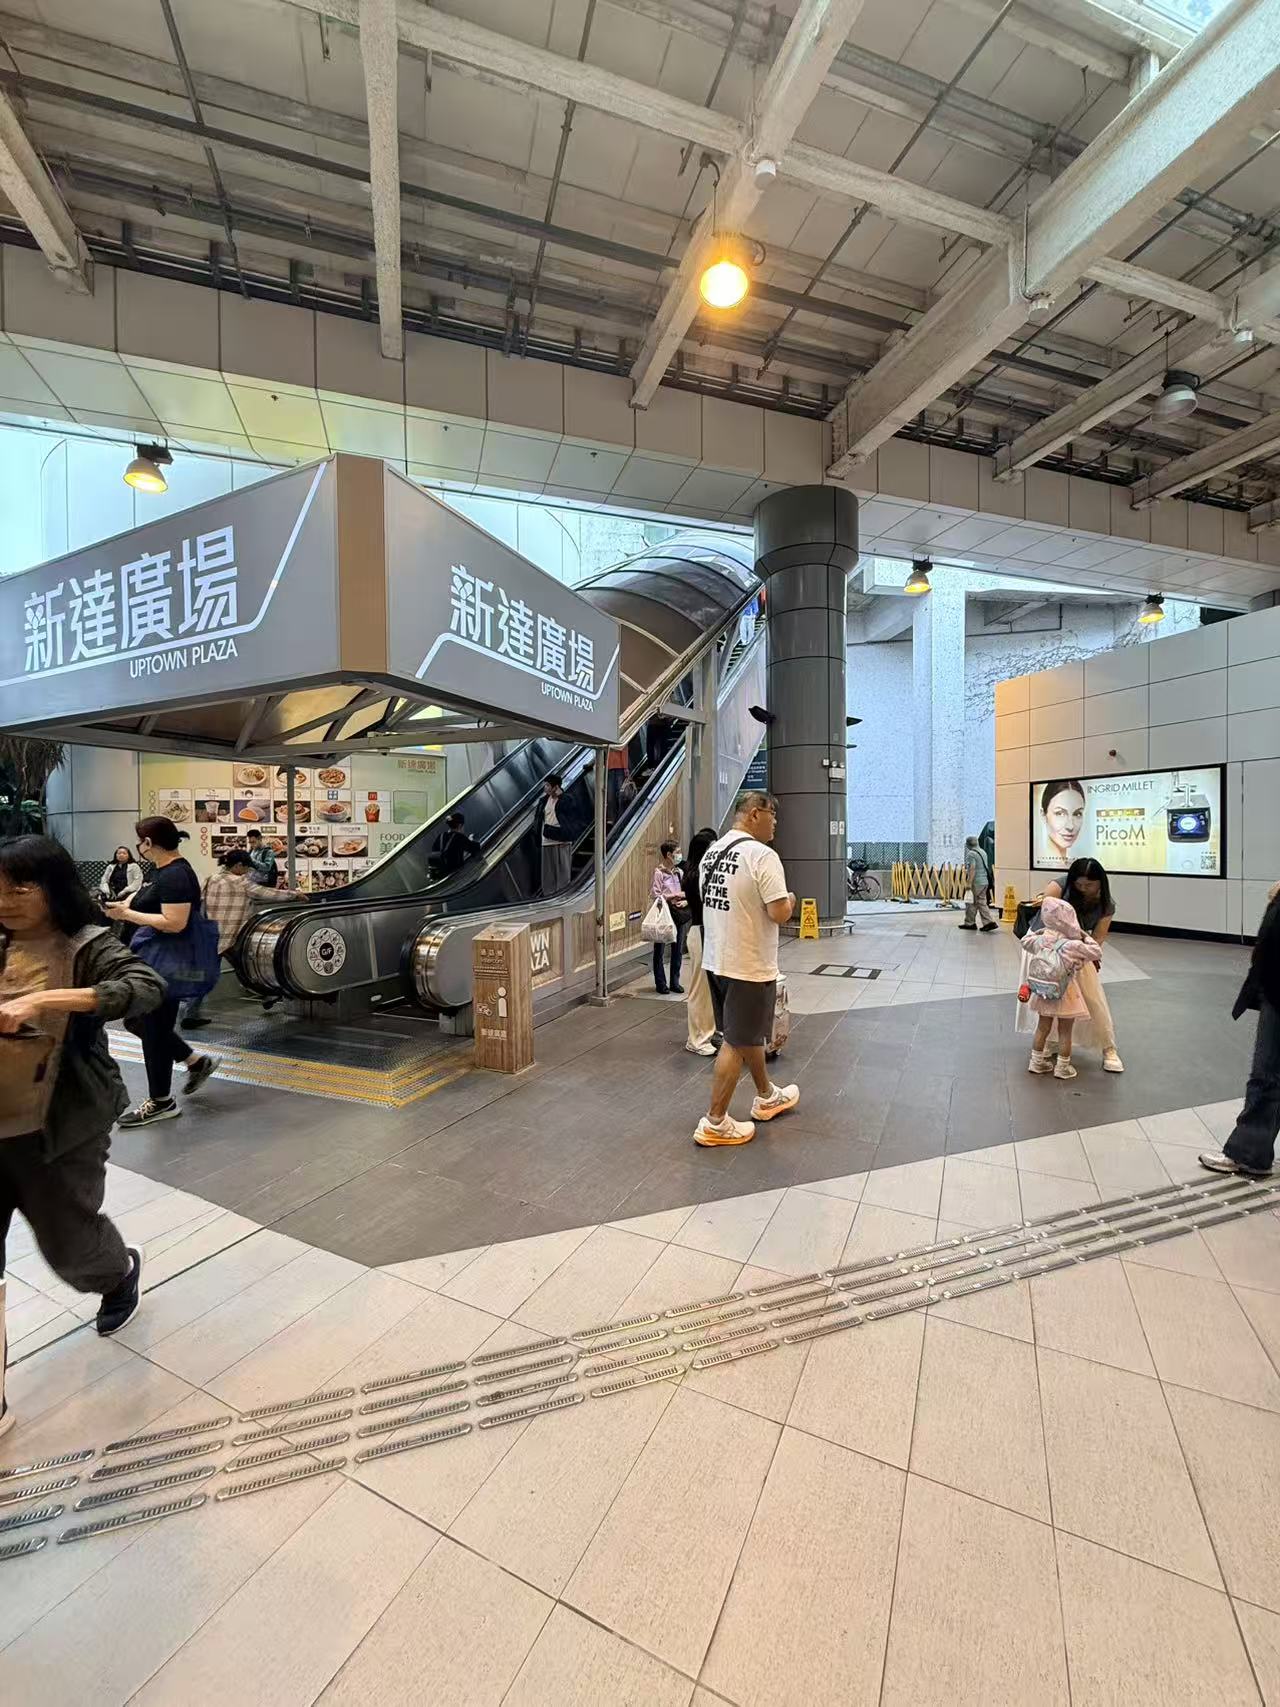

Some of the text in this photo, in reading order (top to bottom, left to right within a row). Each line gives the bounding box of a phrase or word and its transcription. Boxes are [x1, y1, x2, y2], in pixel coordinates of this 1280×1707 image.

[24, 524, 238, 672] 新達廣場
[450, 563, 595, 693] 新達廣場
[130, 638, 238, 678] UPTOWN PLAZA
[541, 681, 593, 712] UPTOWN PLAZA
[1087, 783, 1120, 794] INGRID
[1122, 780, 1155, 791] MILLET
[1096, 824, 1146, 840] PicoM
[704, 851, 740, 862] BECME
[715, 862, 739, 875] EXT
